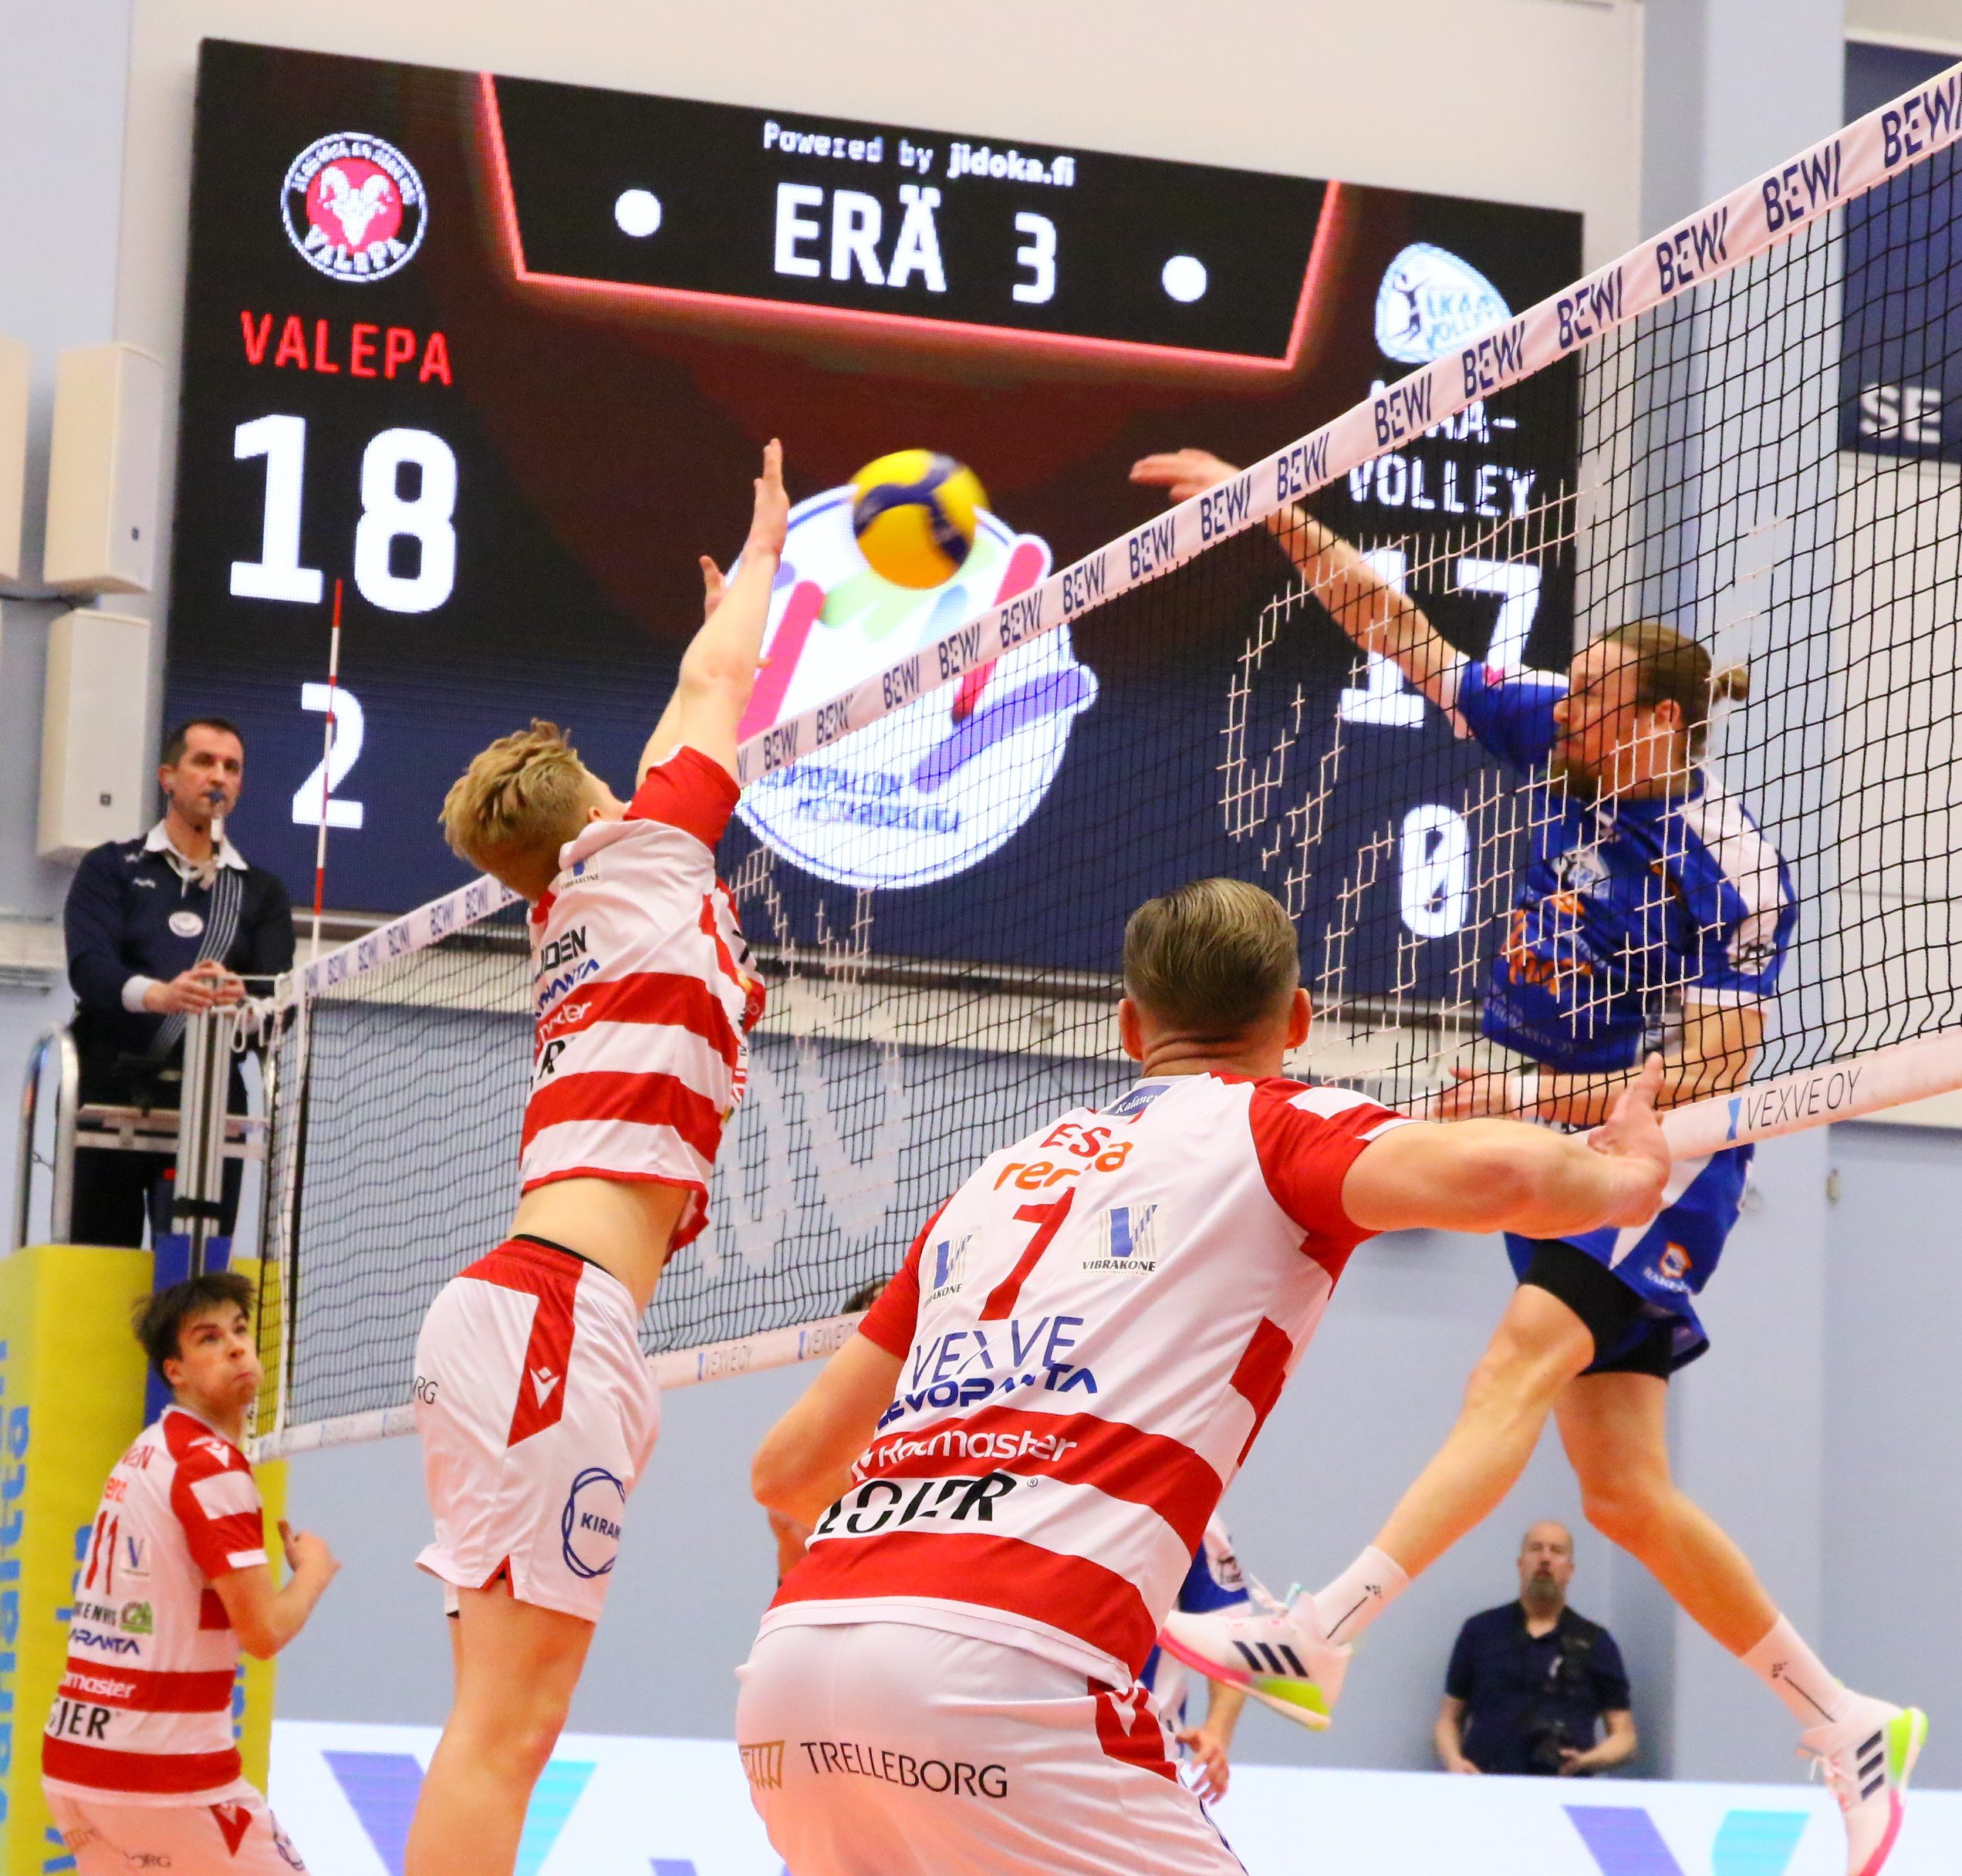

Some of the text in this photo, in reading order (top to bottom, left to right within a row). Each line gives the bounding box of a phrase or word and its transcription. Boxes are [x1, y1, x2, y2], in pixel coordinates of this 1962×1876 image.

[763, 120, 1075, 187] Powered by jidoka.fi
[1882, 71, 1962, 168] BEWI
[1763, 140, 1842, 233] BEWI
[773, 182, 1057, 304] ERÄ 3
[1656, 208, 1727, 295] BEWI
[1557, 266, 1623, 349] BEWI
[240, 310, 452, 386] VALEPA
[1462, 320, 1525, 399] BEWI
[1374, 373, 1432, 447] BEWI
[1859, 383, 1942, 444] SE
[1277, 432, 1329, 501] BEWI
[1349, 453, 1536, 519] VOLLEY
[230, 414, 458, 613] 18
[1201, 474, 1251, 542] BEWI
[1129, 516, 1175, 580] BEWI
[1001, 589, 1043, 647] BEWI
[1062, 553, 1106, 615] BEWI
[938, 623, 981, 680] BEWI
[1341, 549, 1541, 728] 17
[883, 654, 920, 710] BEWI
[292, 682, 364, 829] 2
[762, 721, 799, 771] BEWI
[1082, 1260, 1157, 1272] VIBRAKONE
[800, 1742, 1008, 1799] TRELLEBORG
